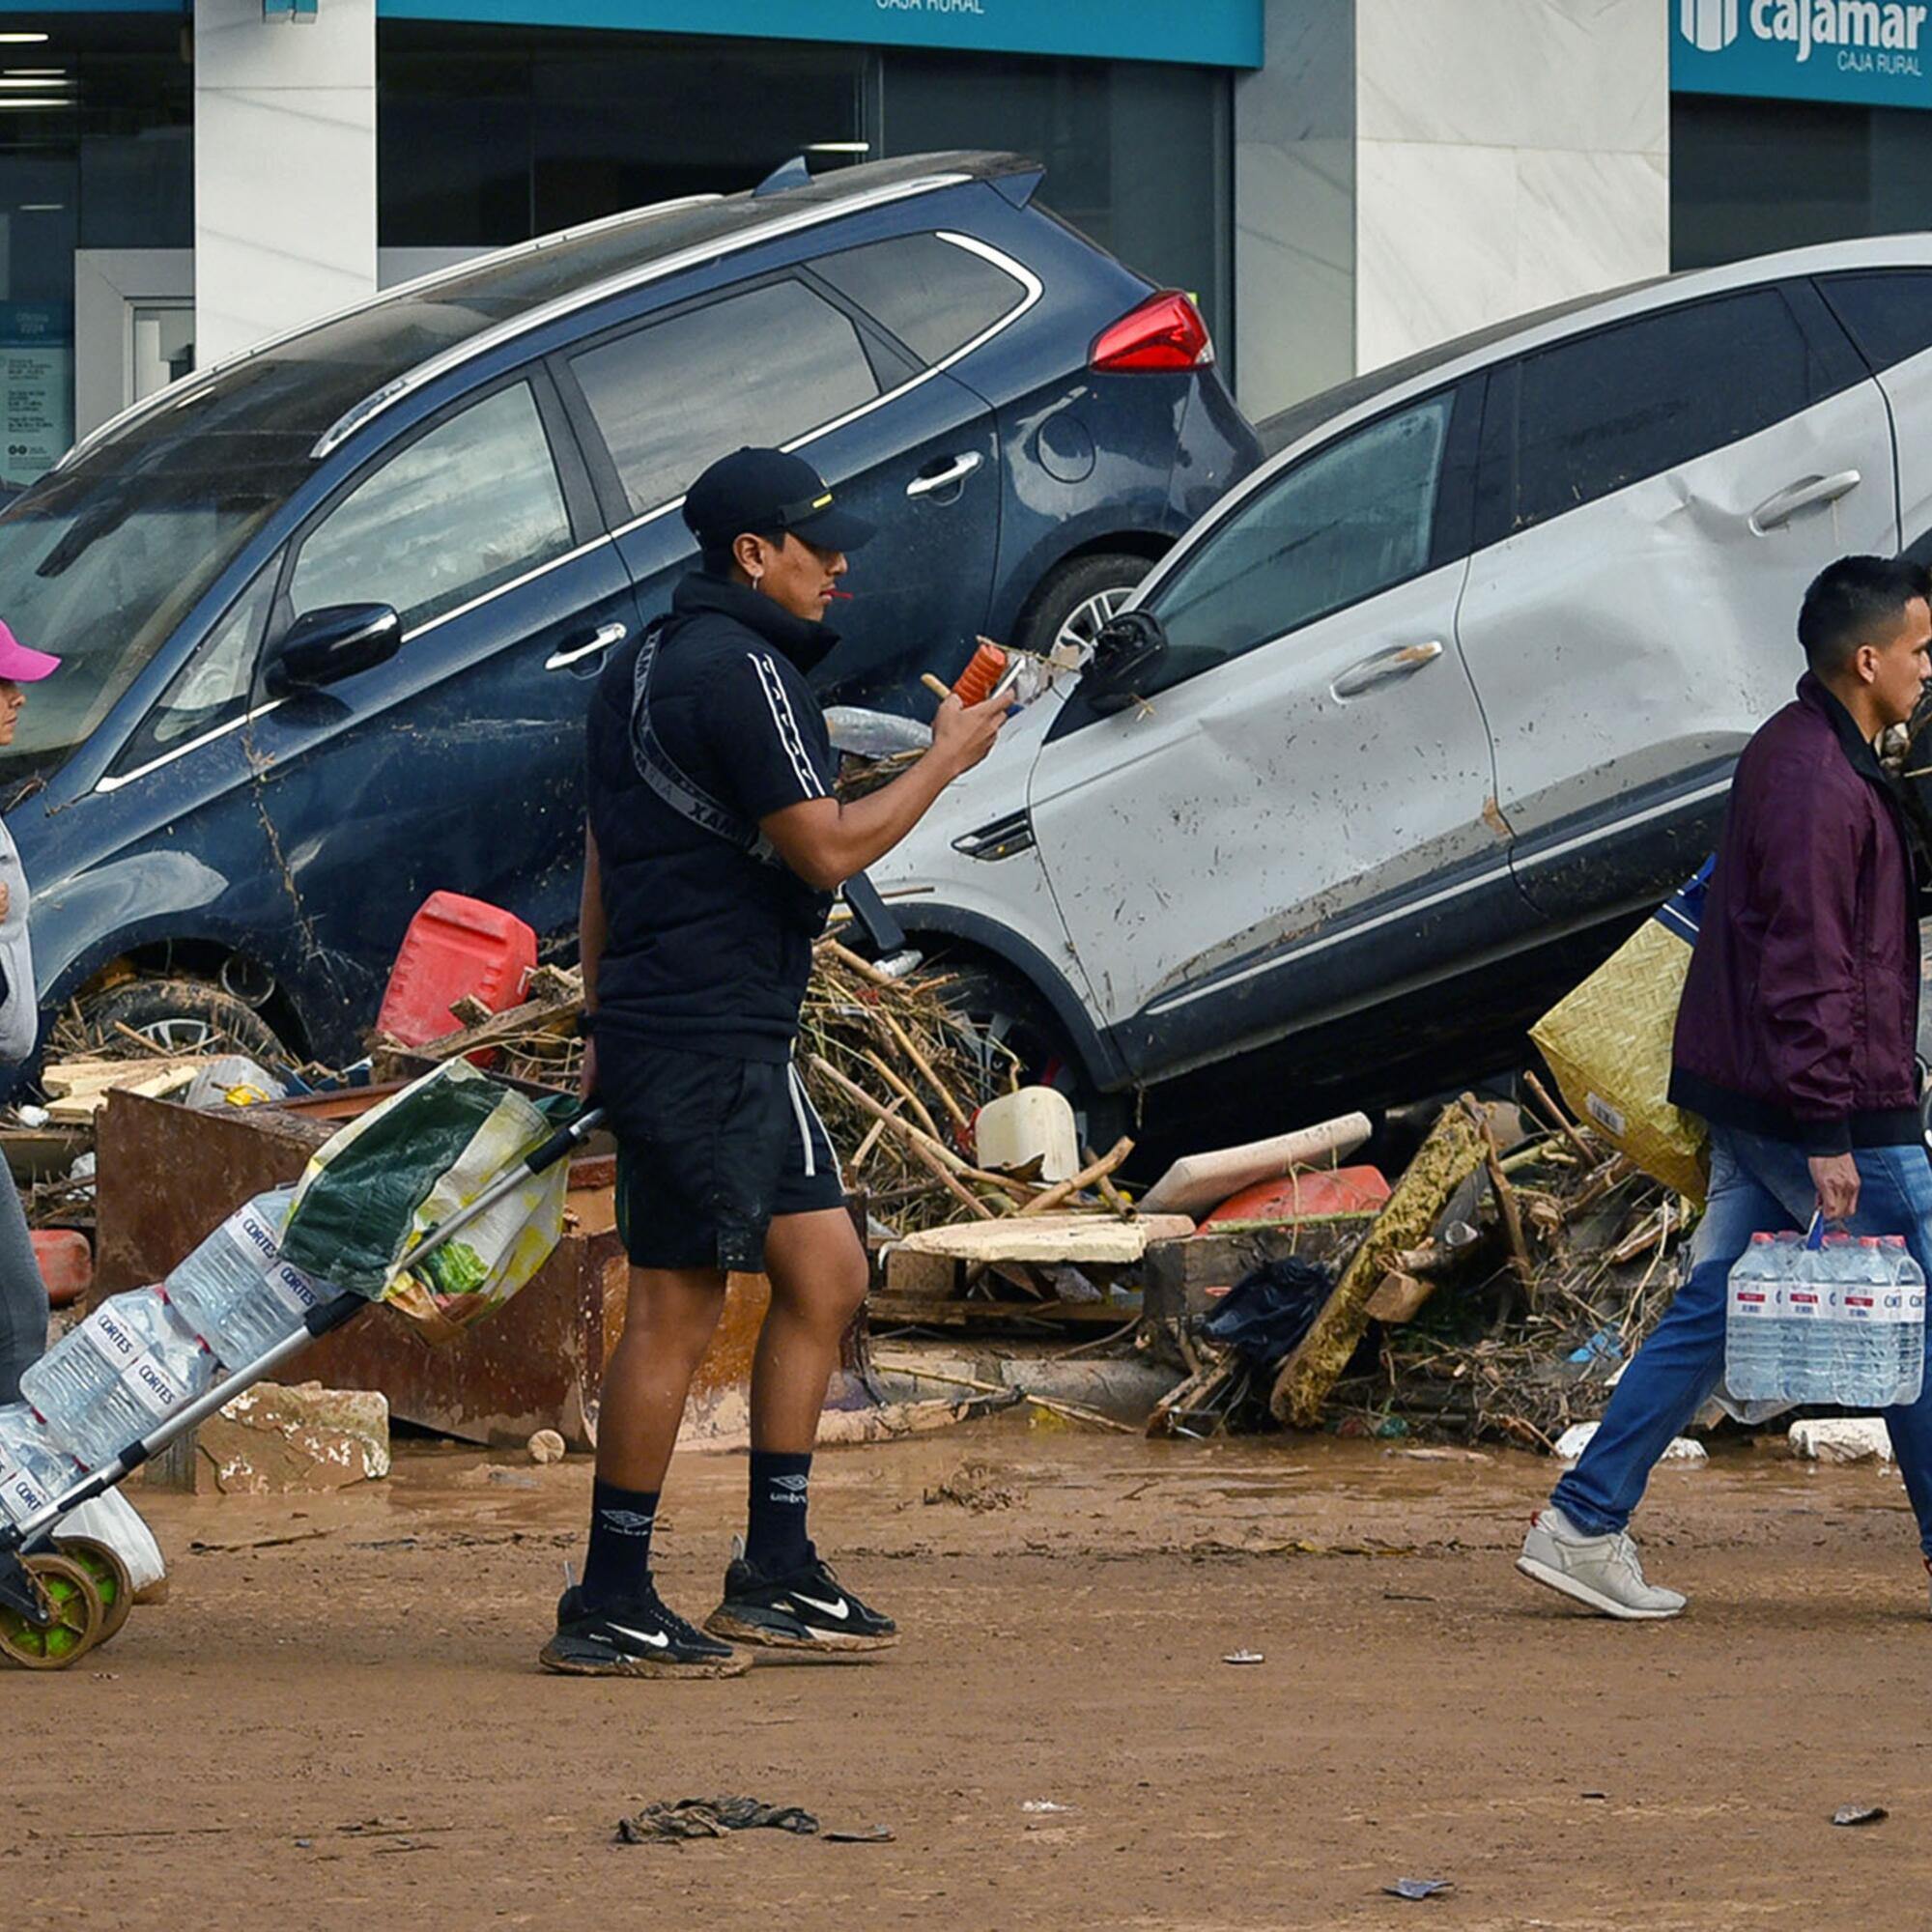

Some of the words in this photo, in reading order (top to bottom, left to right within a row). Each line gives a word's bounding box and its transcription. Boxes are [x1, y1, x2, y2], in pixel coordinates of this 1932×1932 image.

[1750, 0, 1927, 62] cajamar
[1837, 50, 1875, 72] CAJA
[1877, 53, 1922, 76] RURAL
[280, 1266, 318, 1307] CORTES
[98, 1314, 133, 1354] CORTES
[138, 1364, 176, 1405] CORTES
[15, 1481, 43, 1511] CORT
